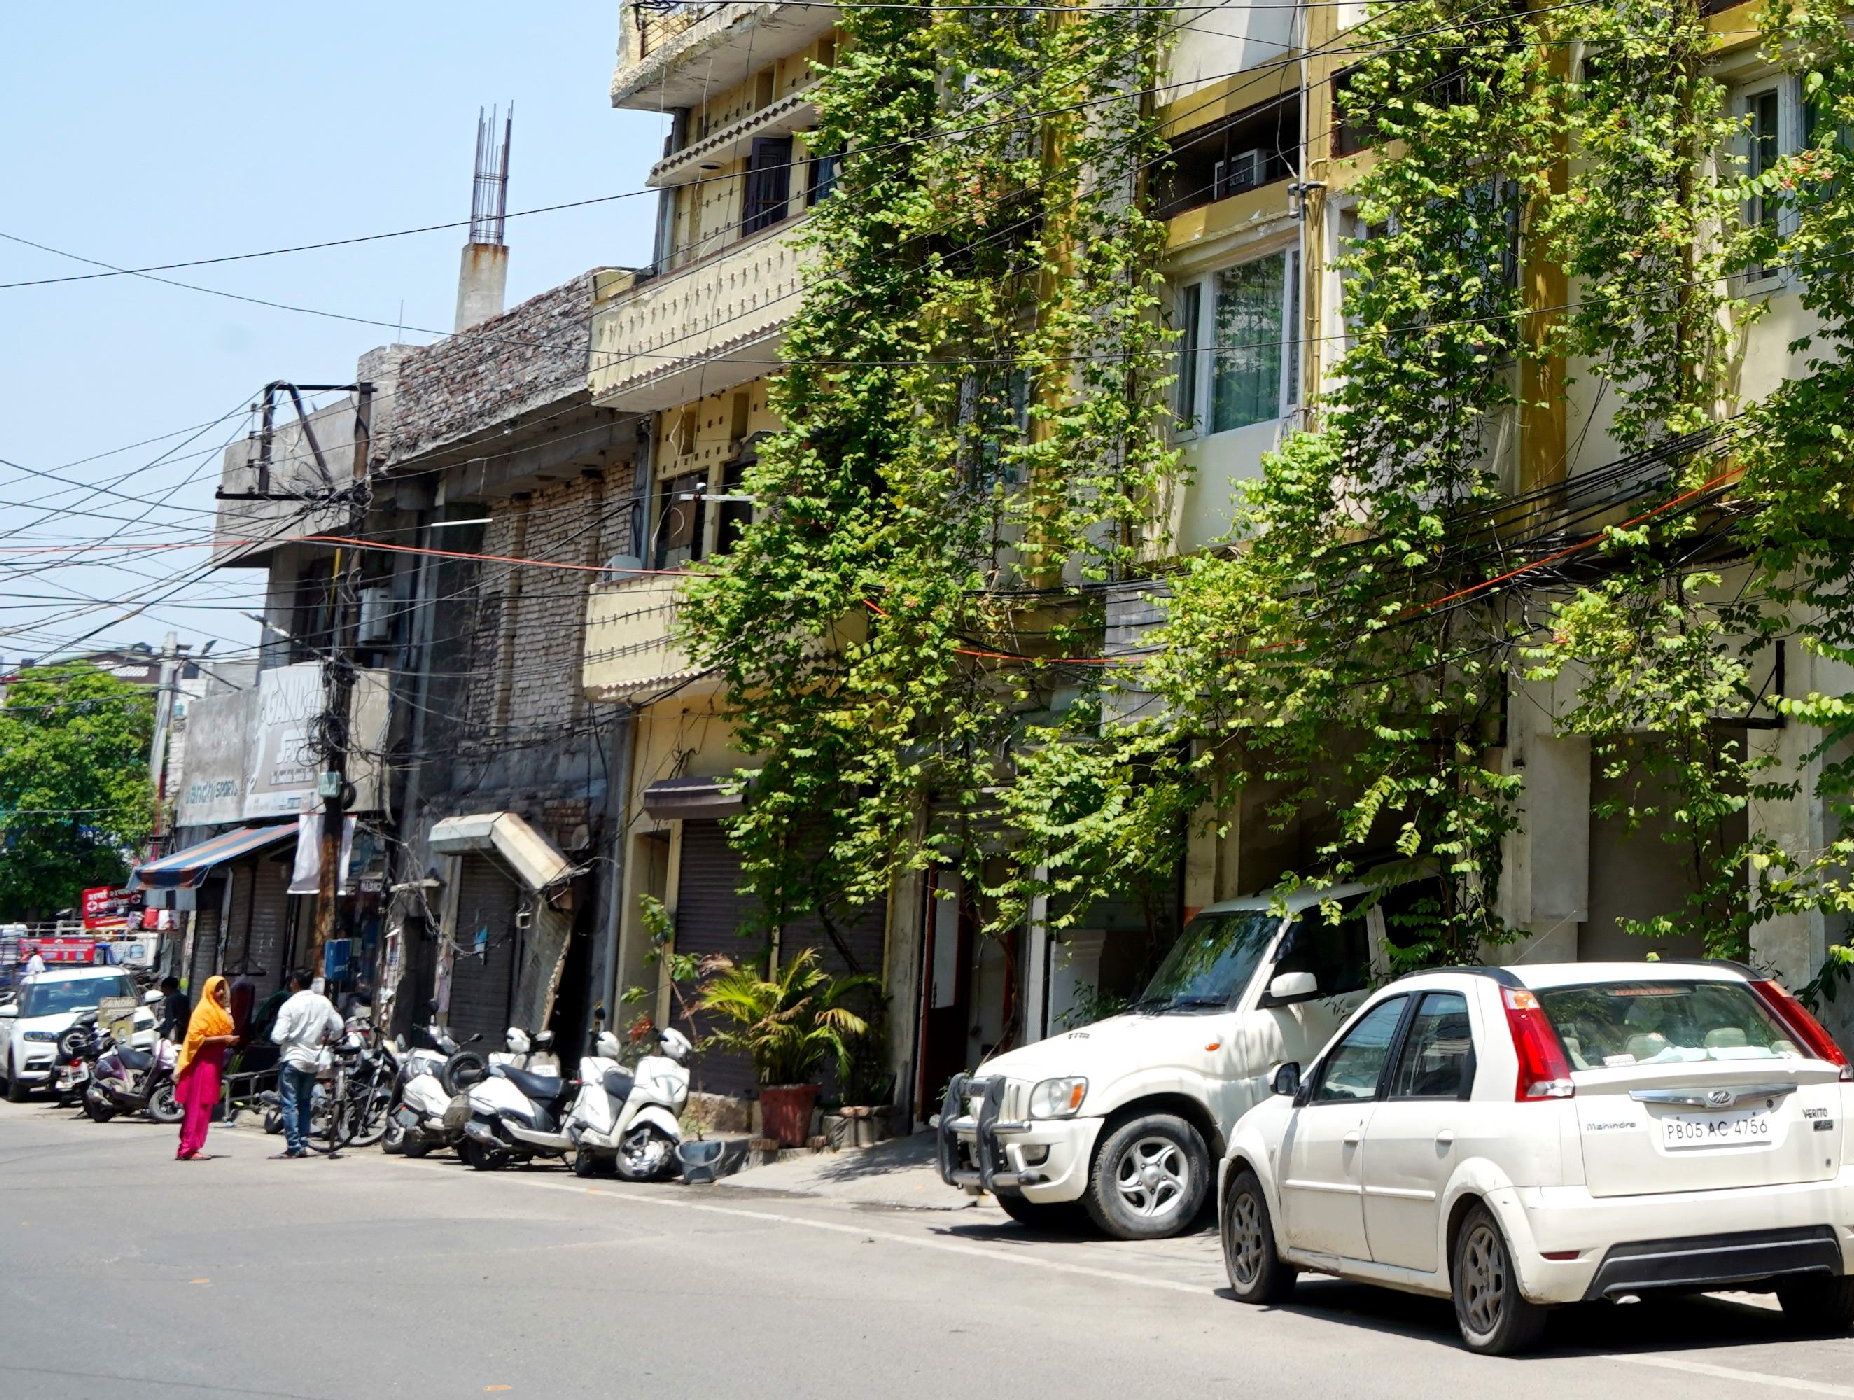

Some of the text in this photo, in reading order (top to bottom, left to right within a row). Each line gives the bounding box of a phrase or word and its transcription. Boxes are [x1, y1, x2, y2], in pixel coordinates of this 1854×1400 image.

[1801, 1107, 1829, 1120] VERITO
[1585, 1119, 1638, 1132] Mahindra
[1706, 1118, 1729, 1139] AC
[1733, 1116, 1769, 1137] 4756
